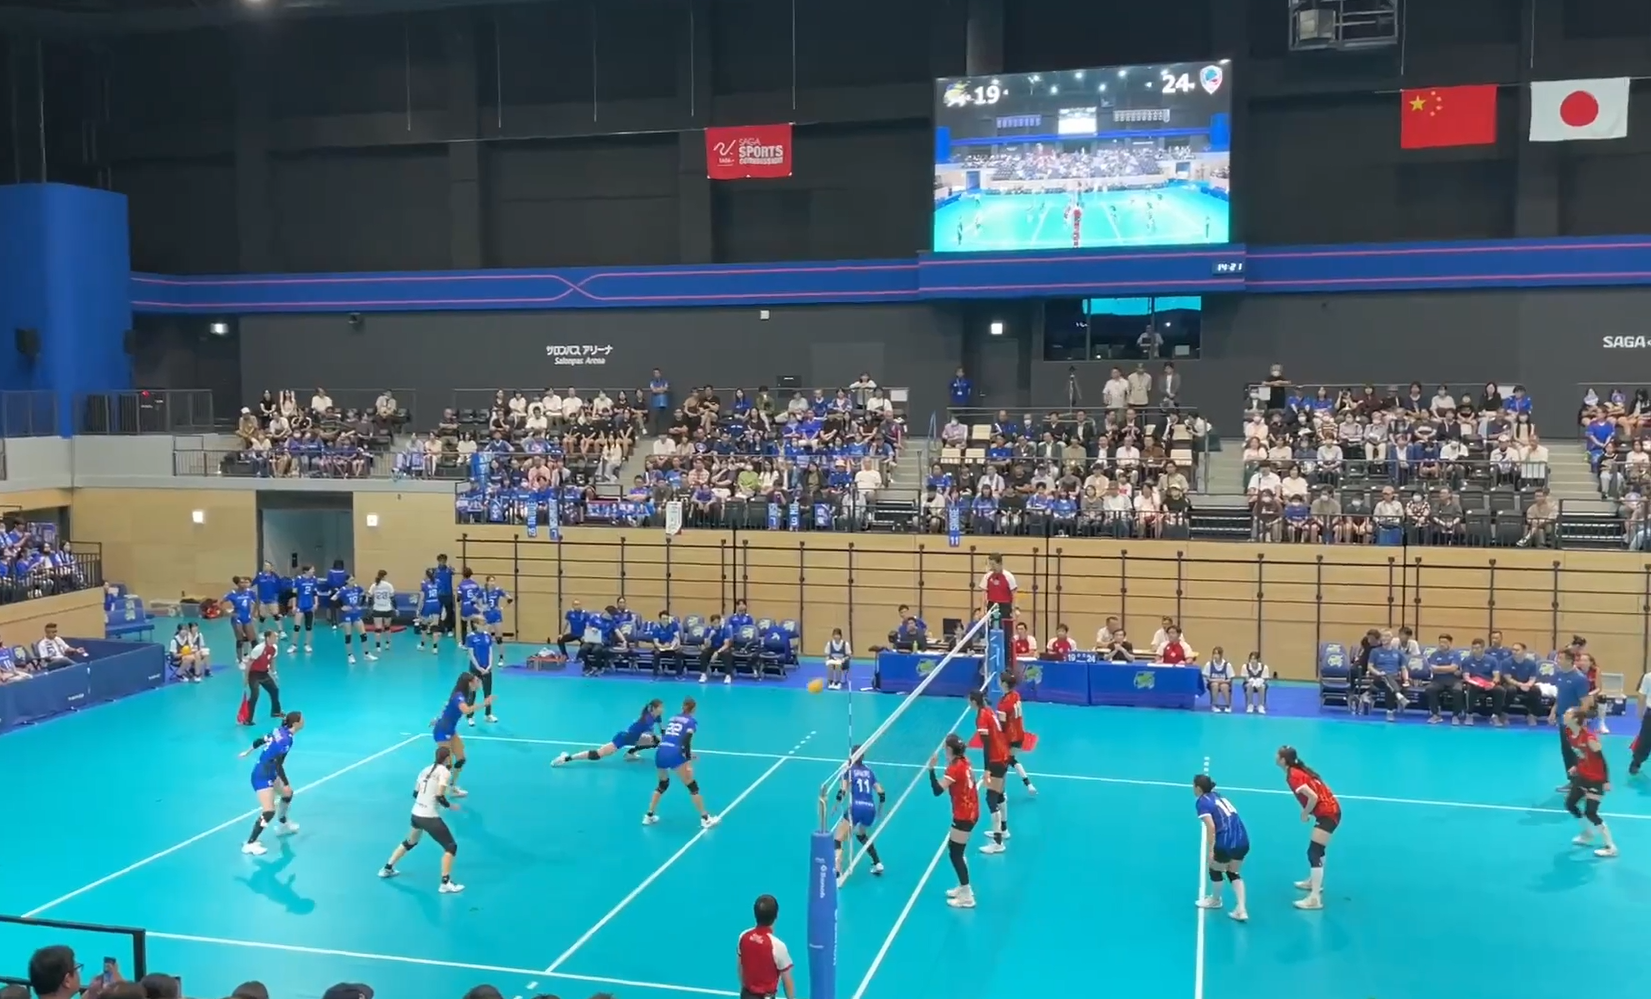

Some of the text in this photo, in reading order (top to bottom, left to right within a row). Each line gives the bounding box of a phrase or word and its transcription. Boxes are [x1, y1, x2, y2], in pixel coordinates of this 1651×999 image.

[1162, 73, 1189, 93] 24
[974, 85, 1001, 105] 19
[739, 138, 761, 146] SAGA
[739, 145, 783, 158] SPORTS
[1603, 335, 1646, 348] SAGA
[582, 344, 613, 355] アリーナ
[1067, 653, 1076, 662] 19
[1086, 653, 1096, 663] 24
[665, 722, 683, 737] 22
[856, 778, 870, 794] 11
